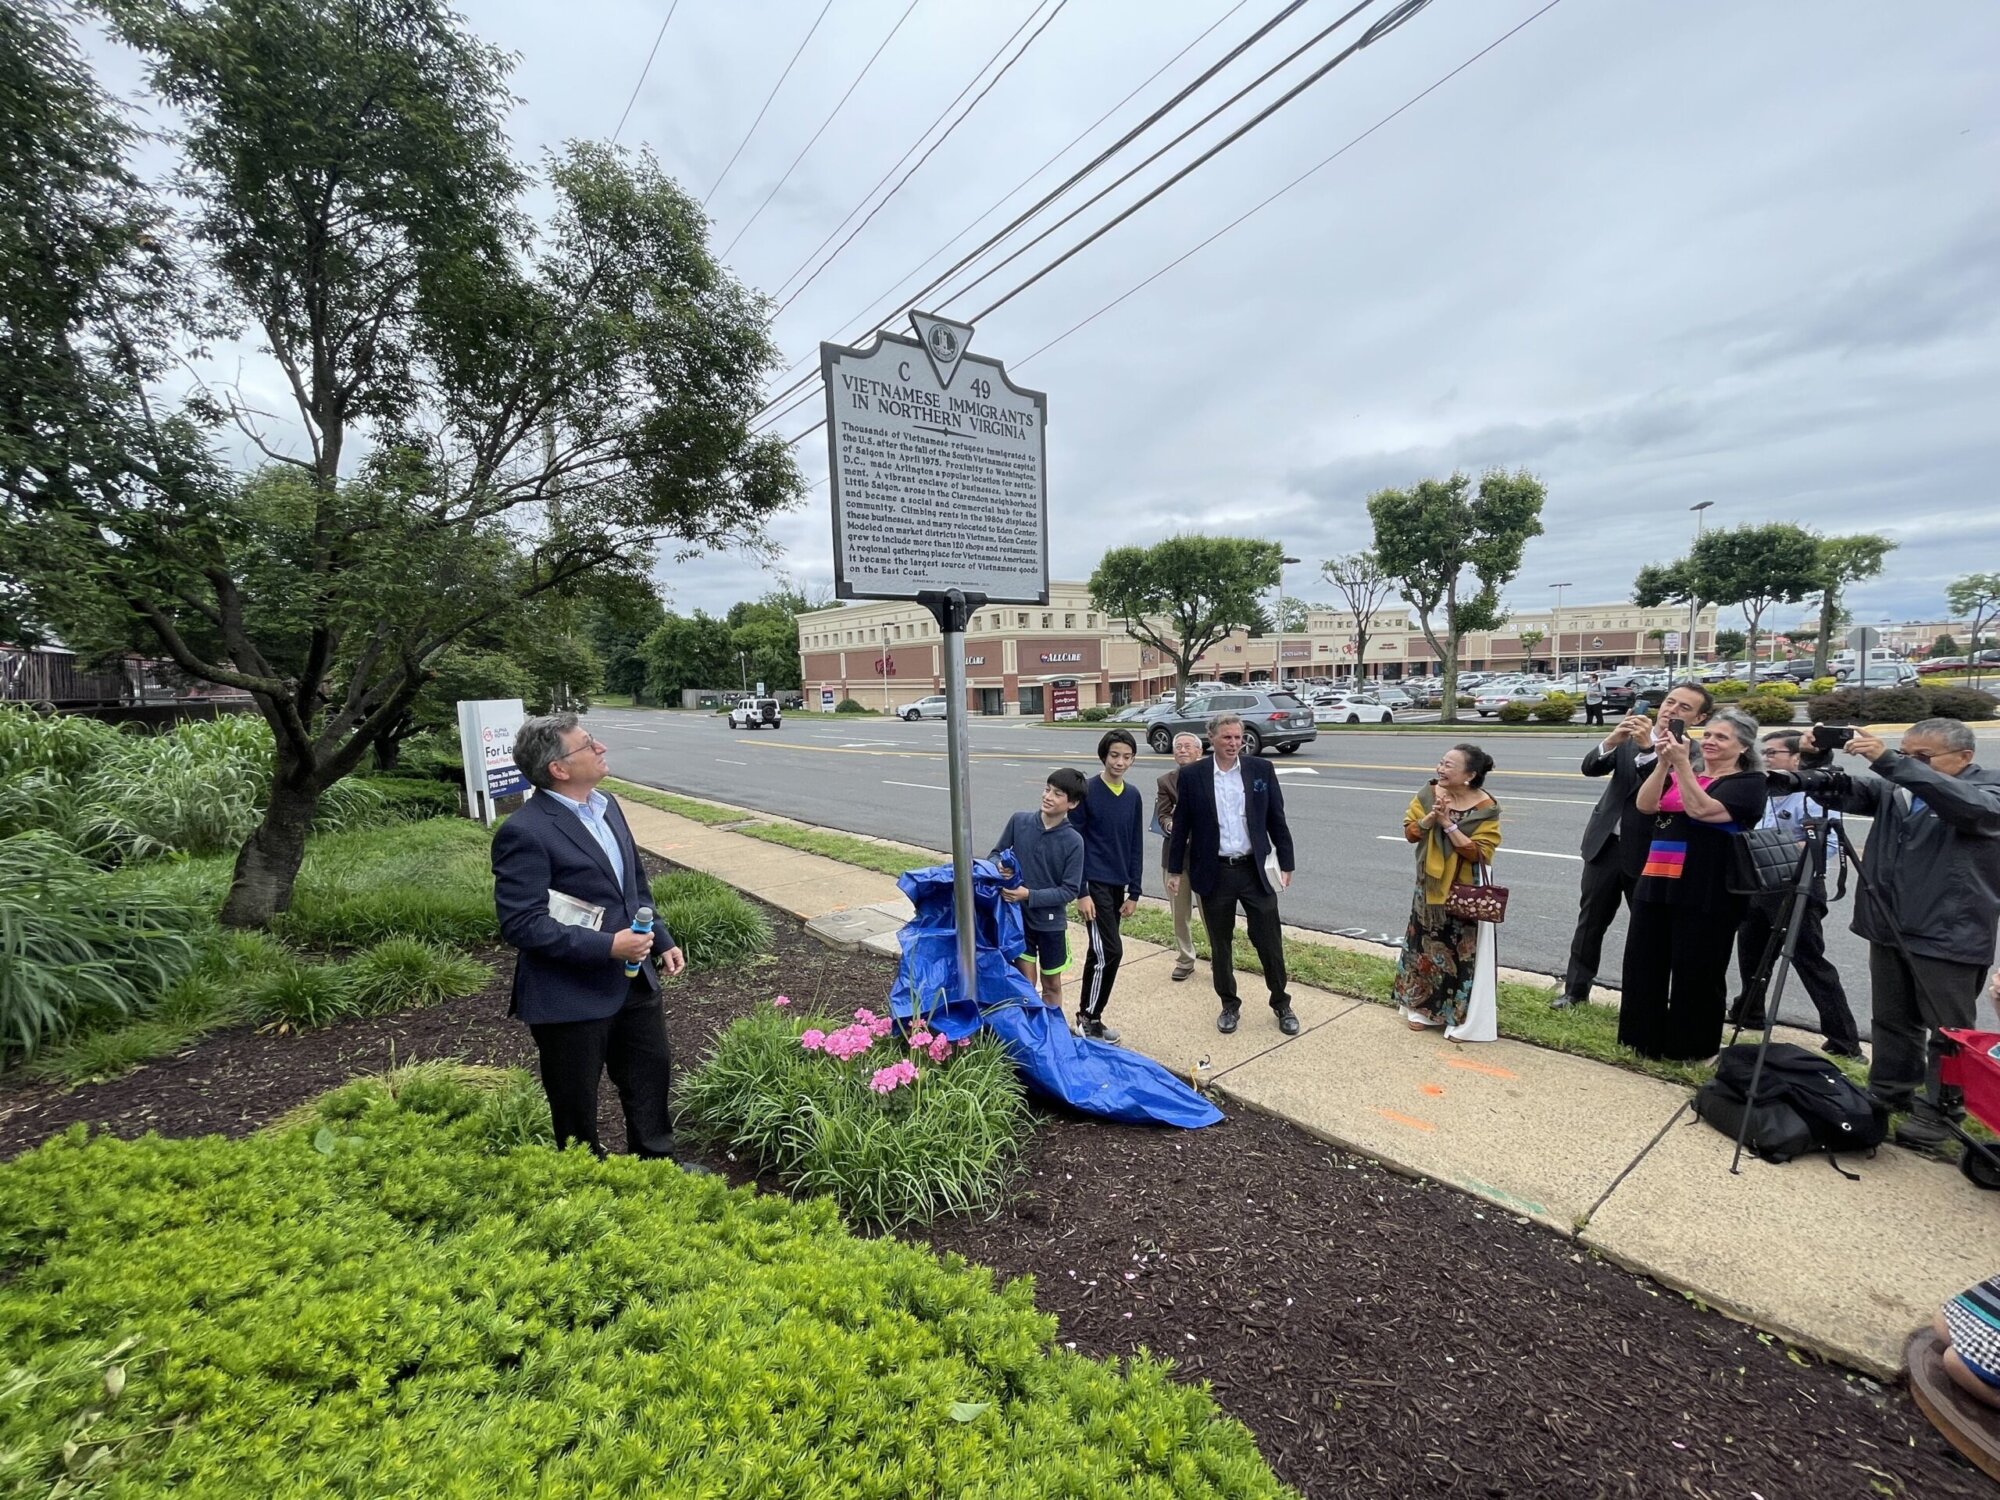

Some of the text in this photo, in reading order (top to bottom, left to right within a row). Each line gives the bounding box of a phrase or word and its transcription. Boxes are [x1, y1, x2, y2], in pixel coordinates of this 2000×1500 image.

[898, 361, 991, 400] C 49
[841, 374, 1034, 427] VIETNAMESE IMMIGRANTS
[852, 393, 1027, 441] IN NORTHERN VIRGINIA
[842, 422, 888, 437] Thousands
[903, 432, 948, 447] Vietnamese
[951, 442, 984, 453] refugees
[987, 447, 1026, 460] immigrated
[843, 433, 857, 443] the
[858, 436, 875, 446] U.S.
[876, 439, 898, 449] after
[899, 442, 913, 452] the
[915, 445, 927, 454] fall
[938, 449, 950, 458] the
[952, 451, 972, 461] South
[973, 454, 1012, 468] Vietnamese
[1013, 463, 1036, 472] capital
[843, 445, 852, 453] of
[855, 446, 884, 458] Saigon
[887, 451, 896, 460] in
[898, 453, 920, 463] April
[922, 456, 942, 467] 1975.
[946, 460, 983, 474] Proximity
[986, 466, 994, 474] to
[844, 468, 869, 478] ment.
[885, 473, 915, 484] vibrant
[918, 478, 948, 488] enclave
[1005, 489, 1027, 498] known
[870, 461, 892, 470] made
[894, 463, 934, 476] Arlington
[942, 471, 970, 481] popular
[972, 474, 1000, 485] location
[1002, 478, 1012, 487] for
[1014, 482, 1036, 490] settle-
[845, 477, 869, 488] Little
[904, 487, 926, 495] arose
[927, 488, 935, 496] in
[937, 489, 950, 498] the
[951, 491, 989, 503] Clarendon
[990, 497, 1037, 509] neighborhood
[846, 490, 862, 498] and
[865, 491, 897, 502] became
[908, 498, 932, 506] social
[953, 503, 994, 513] commercial
[997, 507, 1010, 515] hub
[846, 501, 896, 514] community.
[901, 506, 937, 518] Climbing
[970, 513, 982, 521] the
[984, 515, 1003, 524] 1980s
[1005, 517, 1037, 527] displaced
[847, 511, 870, 520] these
[932, 521, 952, 530] many
[954, 522, 987, 532] relocated
[997, 526, 1013, 534] Eden
[1014, 528, 1037, 537] Center.
[847, 521, 882, 532] Modeled
[896, 527, 923, 536] market
[925, 529, 956, 538] districts
[998, 536, 1014, 544] Eden
[1015, 537, 1038, 546] Center
[872, 534, 880, 542] to
[882, 535, 911, 545] include
[934, 540, 951, 548] than
[965, 543, 984, 552] shops
[857, 545, 891, 554] regional
[892, 547, 930, 558] gathering
[931, 550, 950, 558] place
[963, 552, 1001, 562] Vietnamese
[860, 555, 891, 564] became
[894, 557, 908, 565] the
[910, 558, 938, 568] largest
[978, 563, 1016, 572] Vietnamese
[864, 565, 878, 574] the
[882, 566, 899, 575] East
[902, 568, 928, 576] Coast.
[965, 656, 984, 665] LCARE
[485, 746, 500, 757] For
